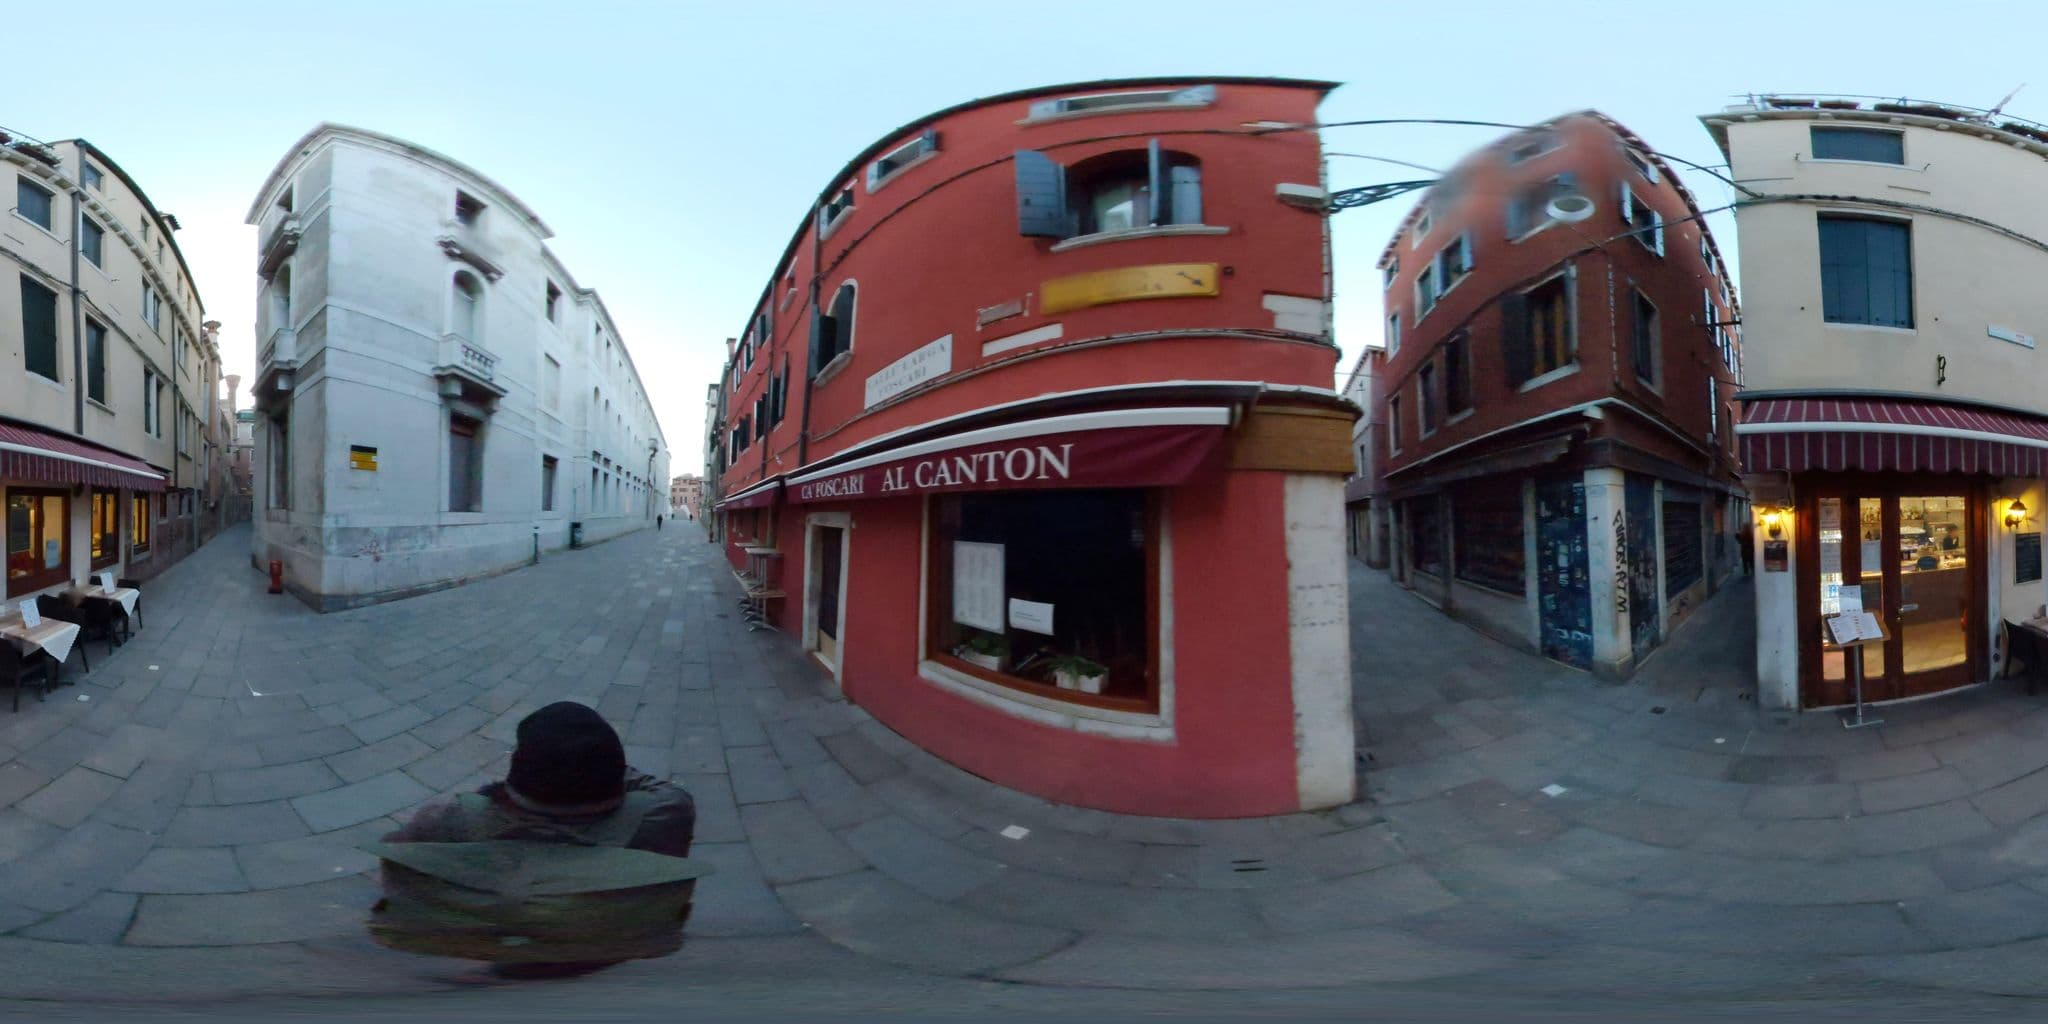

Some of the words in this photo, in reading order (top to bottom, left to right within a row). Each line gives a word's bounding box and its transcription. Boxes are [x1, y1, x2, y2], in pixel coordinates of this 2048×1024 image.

[815, 474, 865, 497] FOSCARI
[881, 465, 909, 492] AL
[914, 443, 1075, 488] CANTON
